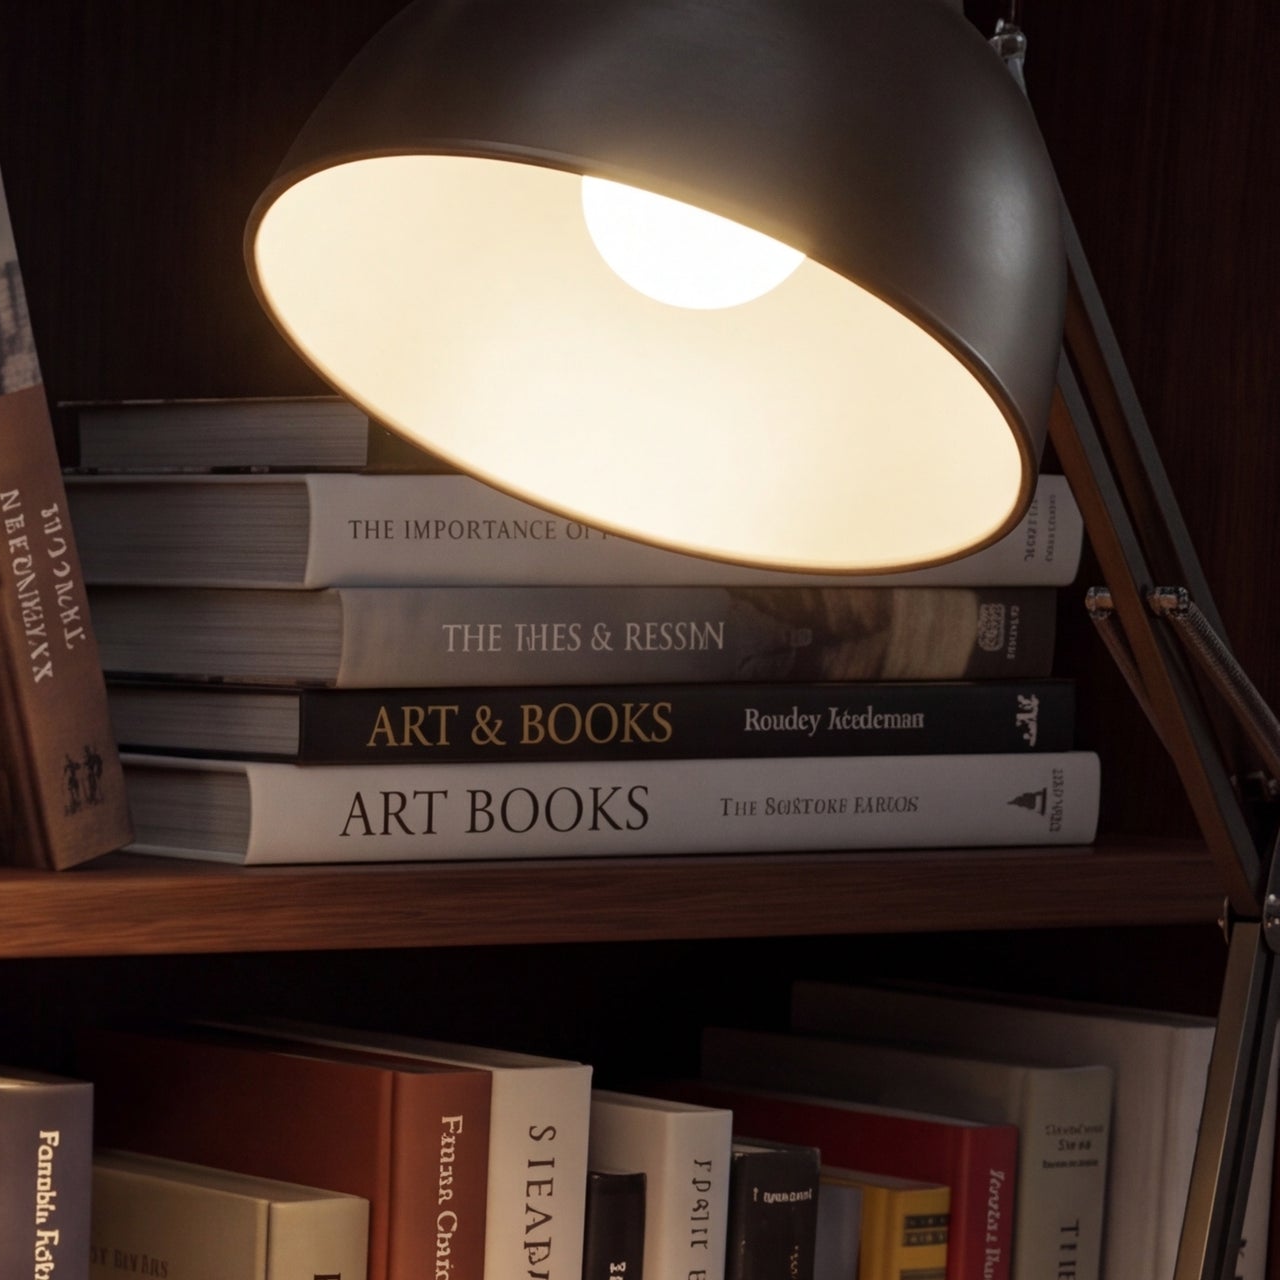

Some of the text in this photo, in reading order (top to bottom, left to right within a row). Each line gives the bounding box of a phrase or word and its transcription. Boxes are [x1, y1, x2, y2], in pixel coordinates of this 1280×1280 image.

[348, 520, 394, 539] THE
[405, 520, 556, 540] IMPORTANCE
[443, 623, 613, 652] THE &
[367, 702, 673, 747] ART & BOOKS
[340, 786, 649, 836] ART BOOKS
